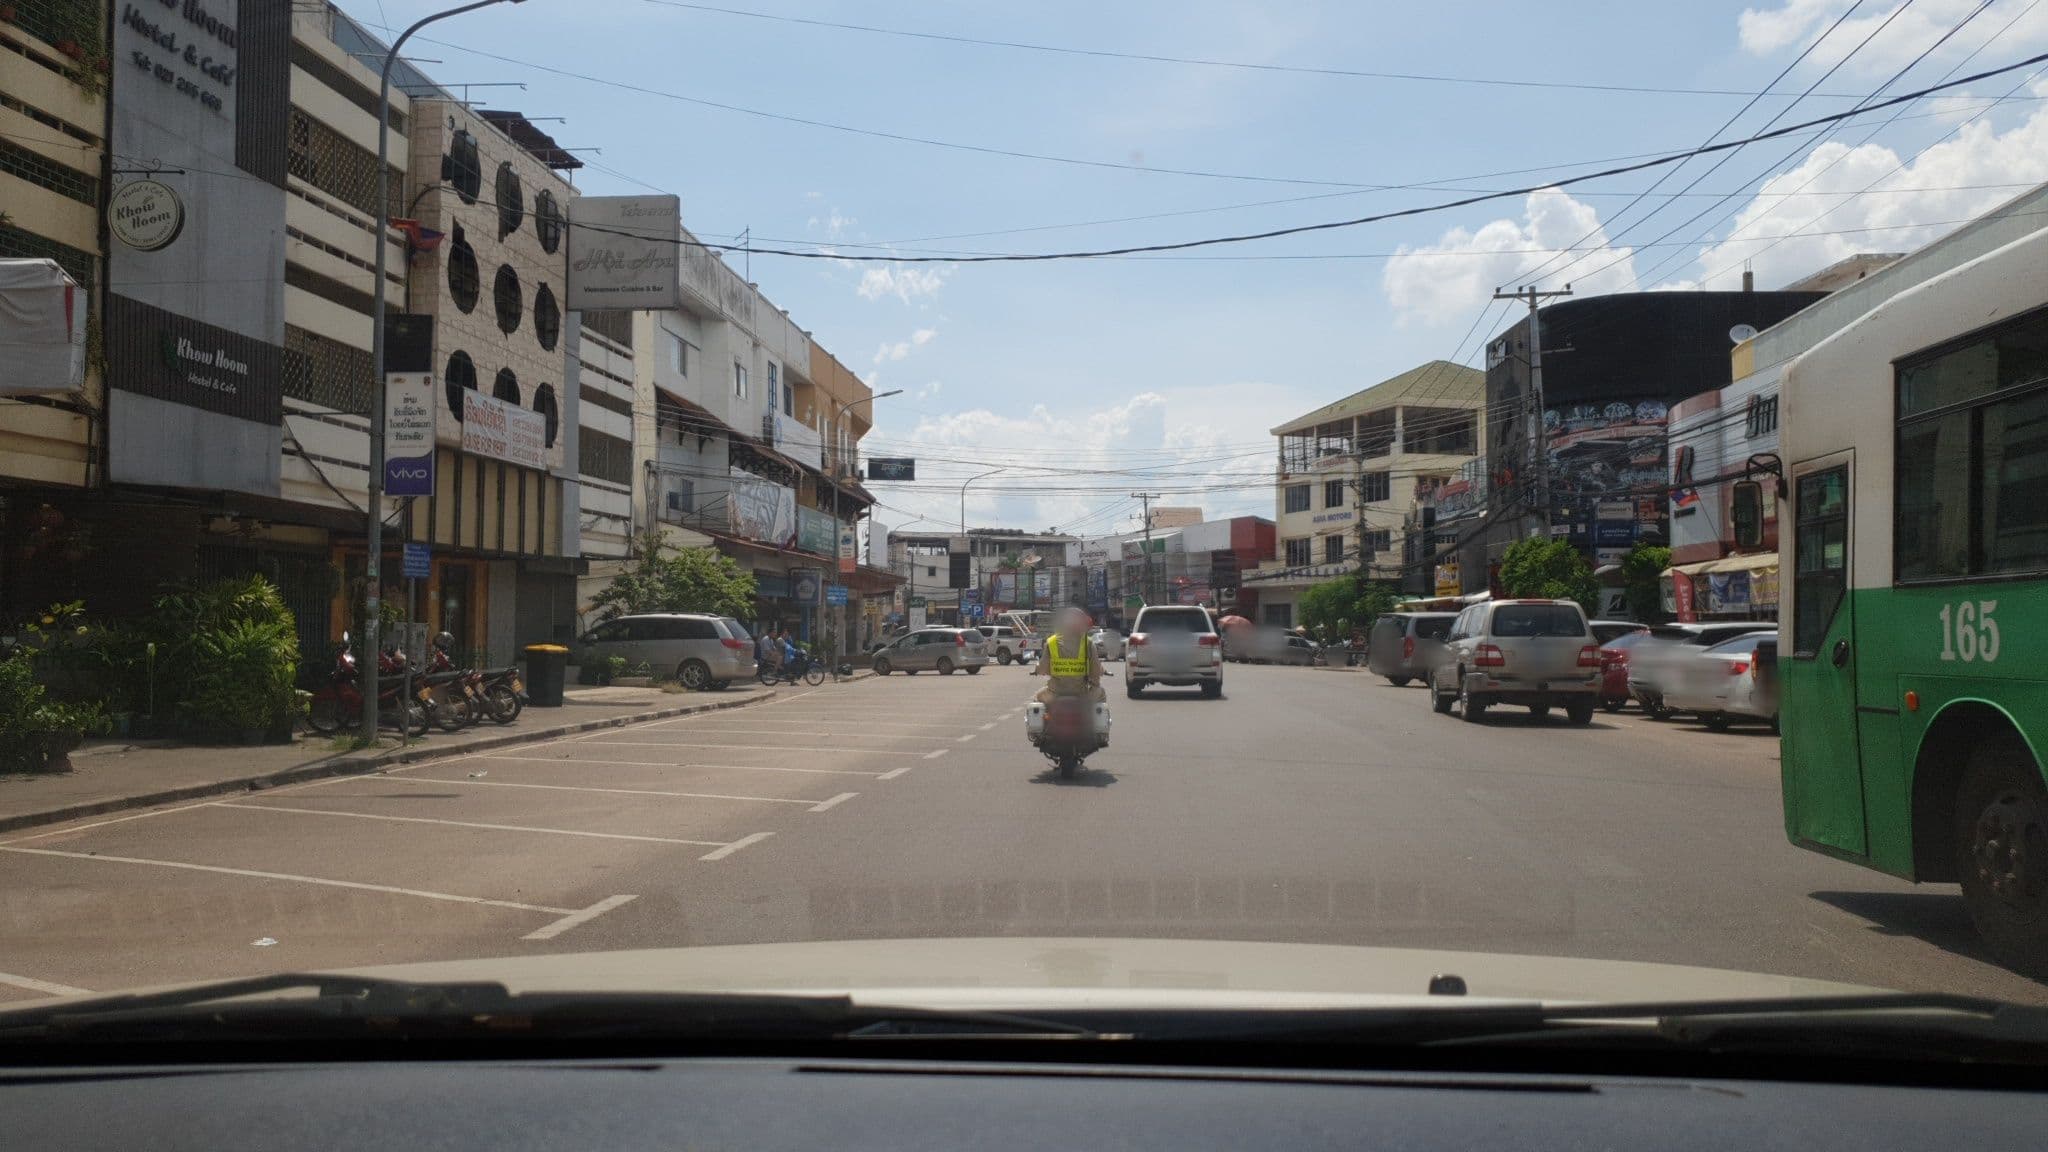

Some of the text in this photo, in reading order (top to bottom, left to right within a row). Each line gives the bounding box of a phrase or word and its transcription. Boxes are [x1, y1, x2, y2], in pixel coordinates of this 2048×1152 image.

[123, 3, 180, 53] Hostel
[184, 43, 197, 66] &
[117, 202, 154, 220] Khow
[652, 285, 664, 293] Bar
[177, 337, 212, 365] Khow
[188, 372, 212, 388] Hostel
[212, 379, 220, 390] &
[390, 467, 427, 479] vivo
[1313, 511, 1353, 523] ASIA MOTORS
[1940, 599, 2000, 662] 165
